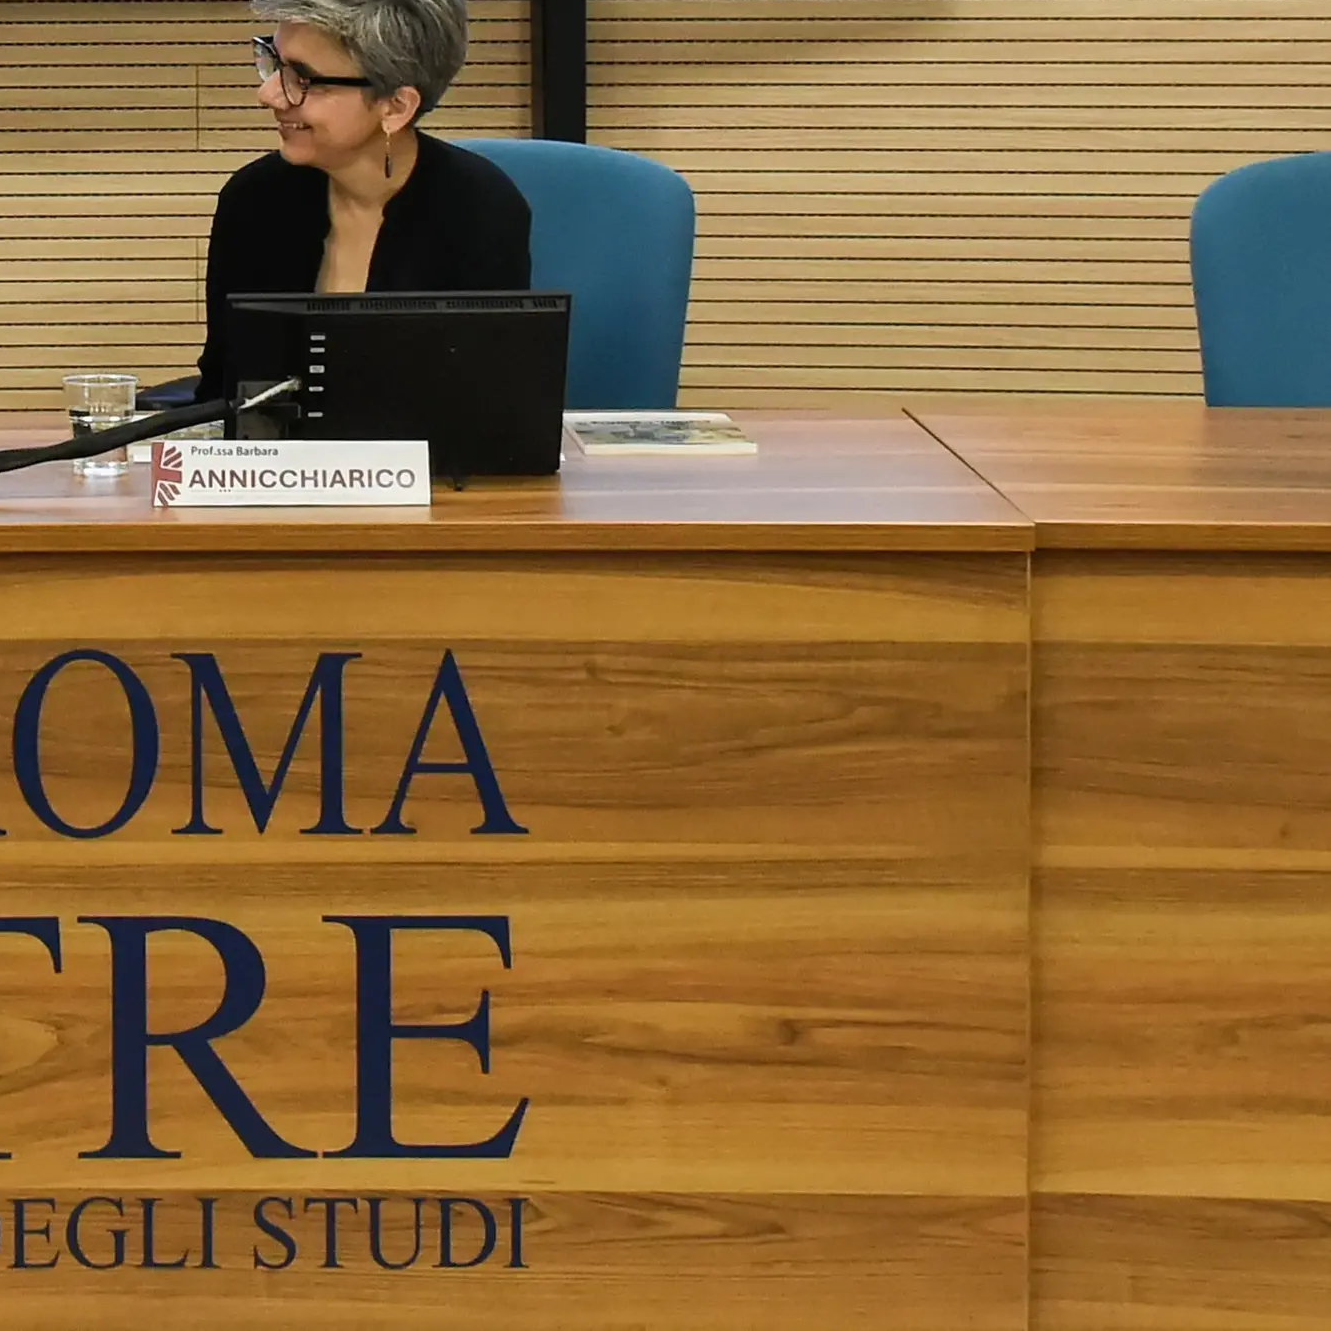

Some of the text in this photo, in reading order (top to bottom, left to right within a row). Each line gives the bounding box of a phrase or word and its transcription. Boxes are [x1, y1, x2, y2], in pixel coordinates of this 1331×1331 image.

[190, 446, 279, 457] Prof.ssa Barbara
[188, 469, 416, 489] ANNICCHIARICO
[252, 1195, 531, 1271] STUDI
